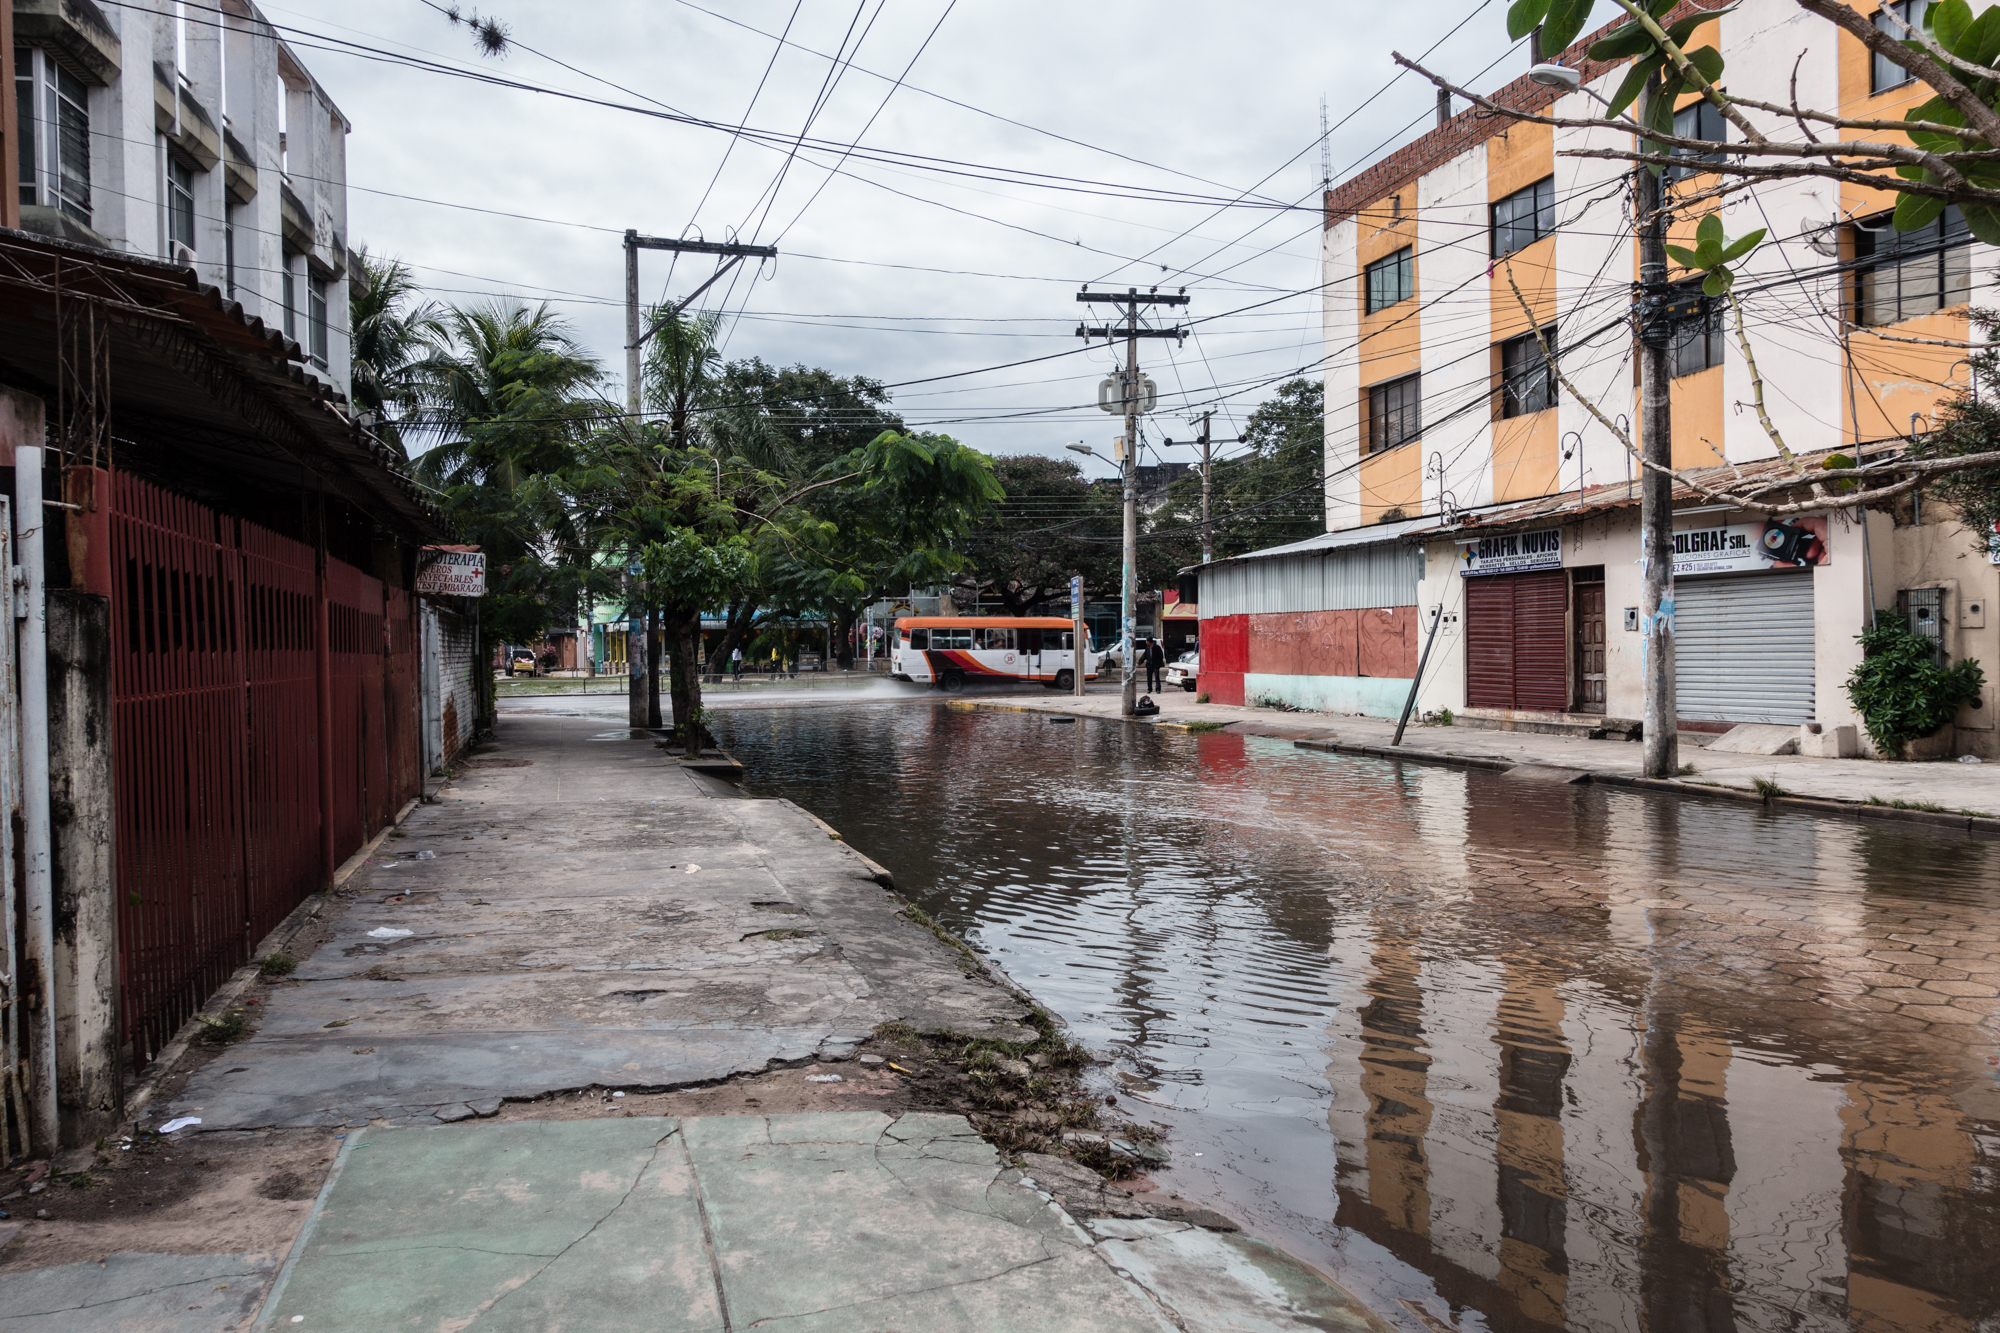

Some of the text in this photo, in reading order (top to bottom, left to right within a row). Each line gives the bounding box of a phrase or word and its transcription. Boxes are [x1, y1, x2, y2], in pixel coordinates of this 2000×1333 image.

[1478, 530, 1560, 559] GRAFIK NUVIS
[1729, 534, 1750, 550] SRL.
[1672, 548, 1751, 561] OLUCIONES GRAFICAS
[418, 573, 475, 584] INYECTABLES
[418, 581, 483, 593] TEST EMBARAZO
